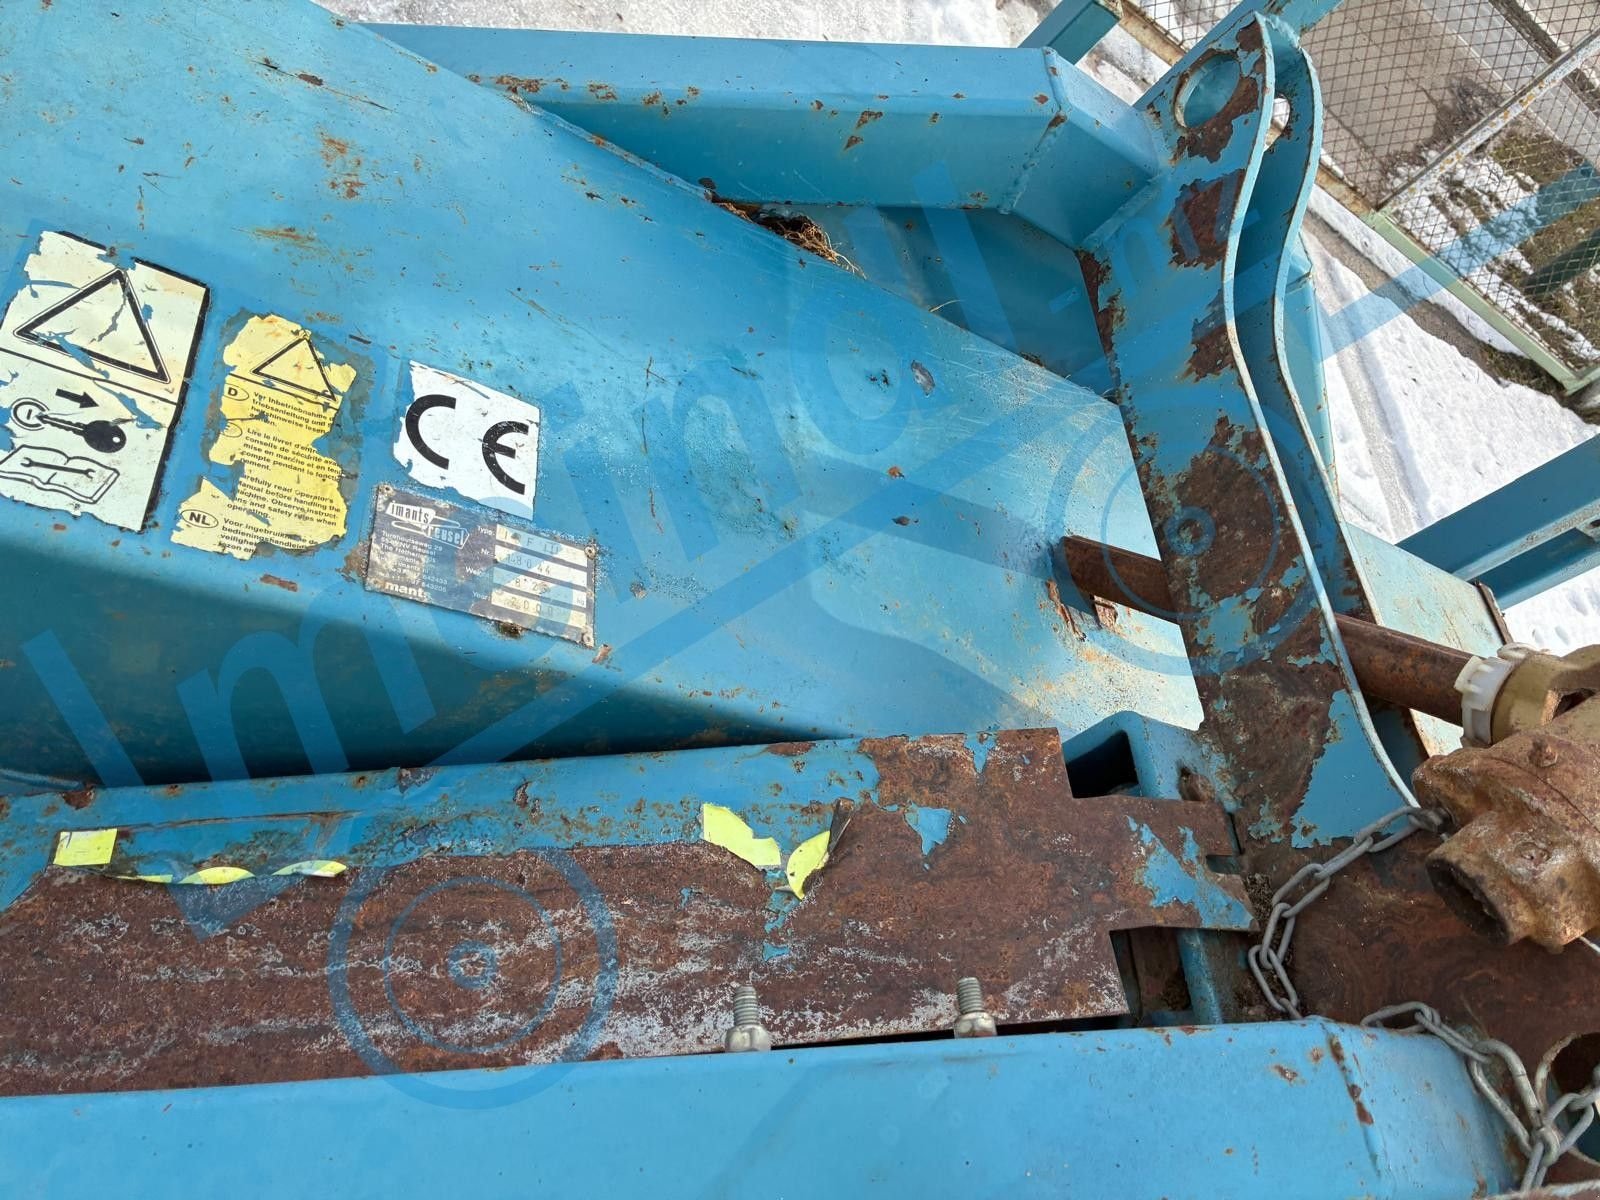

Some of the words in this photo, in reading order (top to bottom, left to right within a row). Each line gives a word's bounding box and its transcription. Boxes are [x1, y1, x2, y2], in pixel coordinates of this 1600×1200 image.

[227, 387, 238, 397] D
[252, 399, 309, 423] triebsanleitung
[311, 419, 326, 427] und
[245, 436, 278, 450] conseils
[280, 445, 289, 453] de
[247, 428, 261, 437] Lire
[272, 435, 292, 446] livret
[405, 394, 529, 495] CE
[243, 443, 263, 453] mise
[307, 461, 314, 469] et
[273, 459, 305, 473] pendant
[274, 483, 292, 493] read
[265, 488, 292, 501] before
[294, 496, 327, 511] handling
[329, 504, 341, 513] the
[271, 498, 307, 513] Observe
[189, 512, 210, 526] NL
[223, 518, 243, 527] Voor
[249, 501, 265, 509] and
[268, 506, 292, 518] safety
[316, 518, 337, 527] when
[391, 501, 429, 523] imants
[427, 526, 464, 546] reusel
[383, 581, 431, 600] mants
